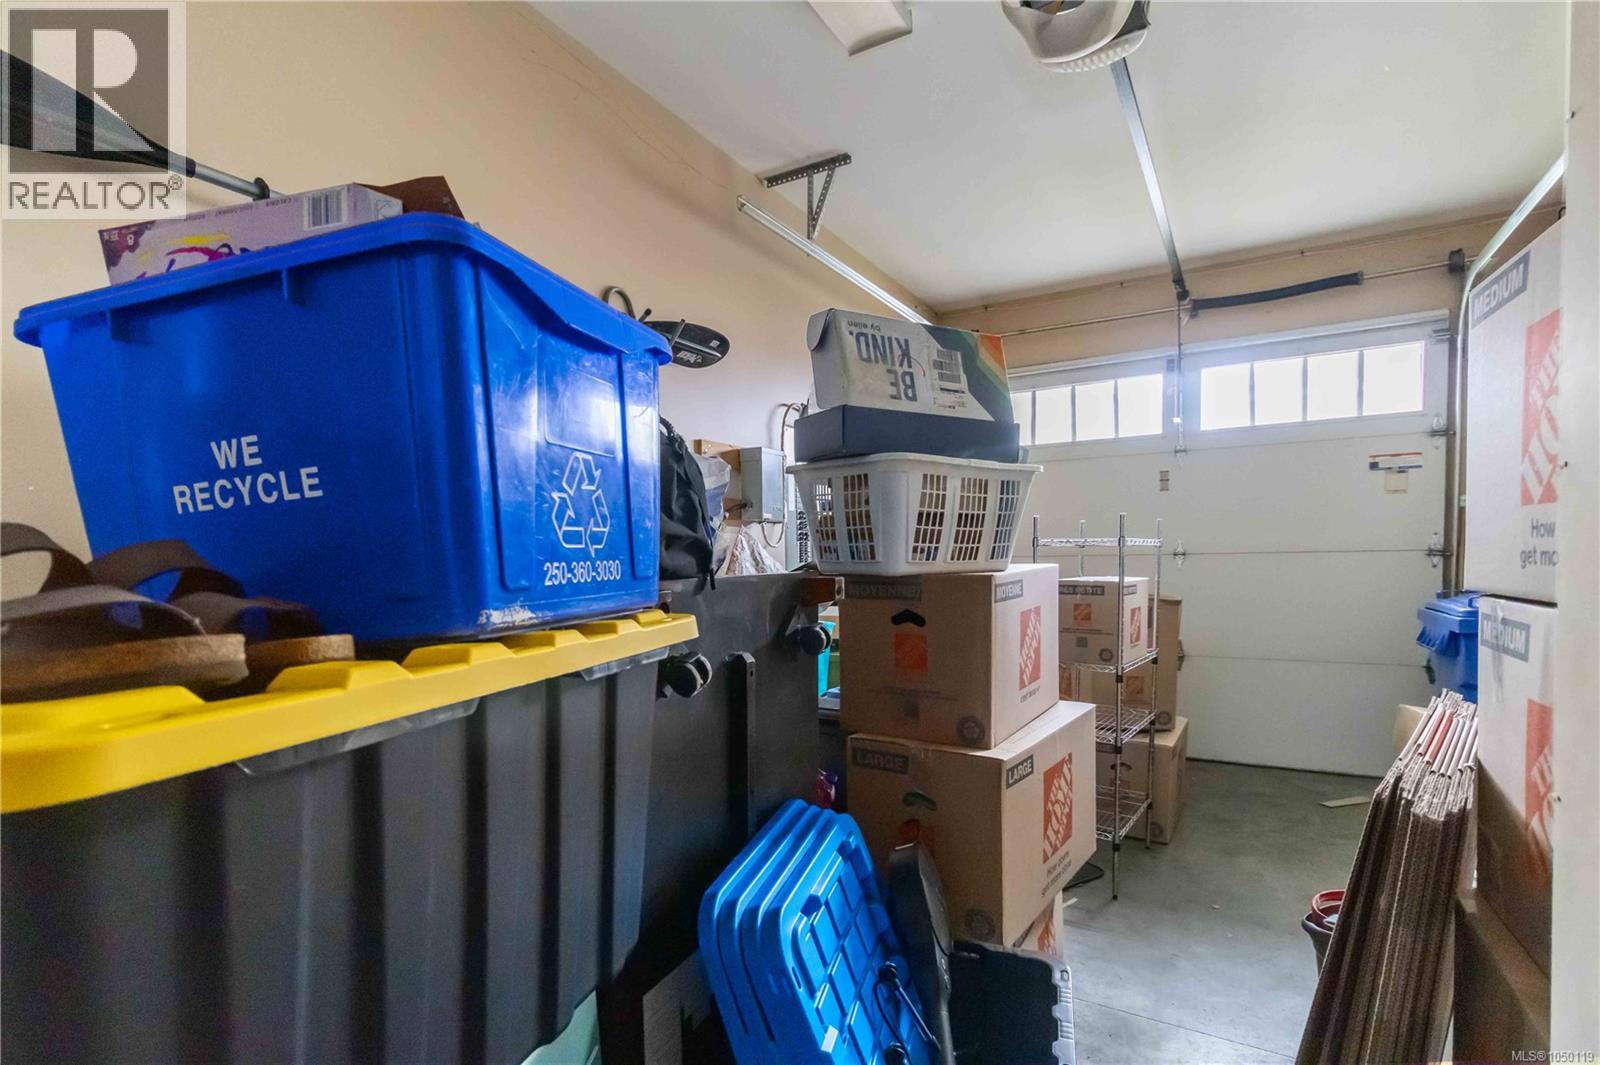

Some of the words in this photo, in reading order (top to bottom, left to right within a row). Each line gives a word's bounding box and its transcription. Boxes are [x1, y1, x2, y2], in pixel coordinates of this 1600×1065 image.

[1474, 262, 1524, 321] MEDIUM
[869, 321, 881, 333] by
[848, 329, 913, 369] KIND.
[887, 368, 918, 402] BE
[210, 435, 262, 470] WE
[172, 466, 324, 514] RECYCLE
[1530, 518, 1556, 538] How
[544, 559, 621, 586] 250-360-3030
[1520, 545, 1537, 570] get
[1540, 550, 1560, 567] mo
[1483, 620, 1526, 654] MEDIUM
[857, 751, 906, 772] LARGE
[1008, 759, 1032, 785] LARGE
